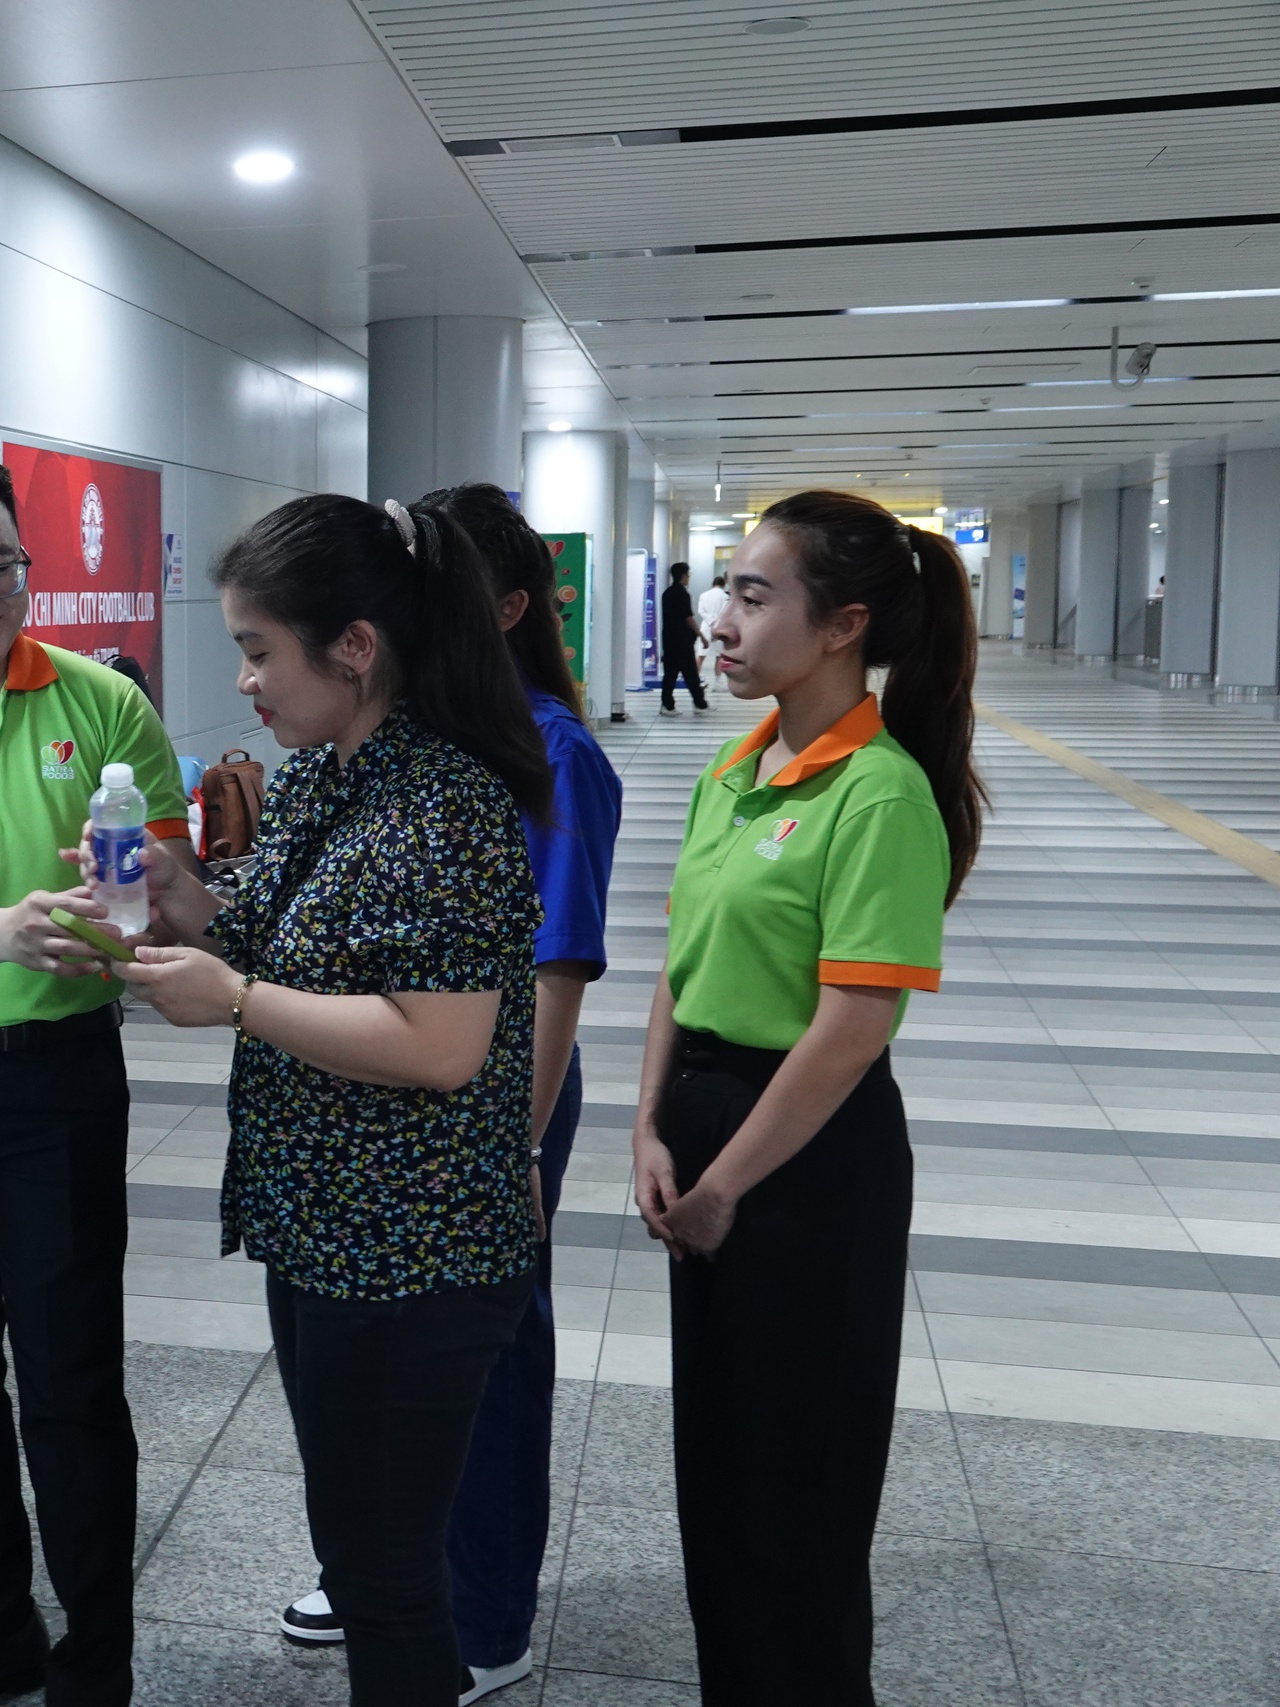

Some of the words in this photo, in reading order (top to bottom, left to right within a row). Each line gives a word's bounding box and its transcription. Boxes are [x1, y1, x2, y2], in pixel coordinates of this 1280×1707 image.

[34, 592, 51, 627] CHI
[52, 592, 78, 626] MINH
[79, 592, 98, 625] CITY
[98, 592, 136, 624] FOOTBALL
[136, 592, 155, 622] CLUB
[41, 765, 74, 773] SATRA
[41, 772, 74, 780] FOODS
